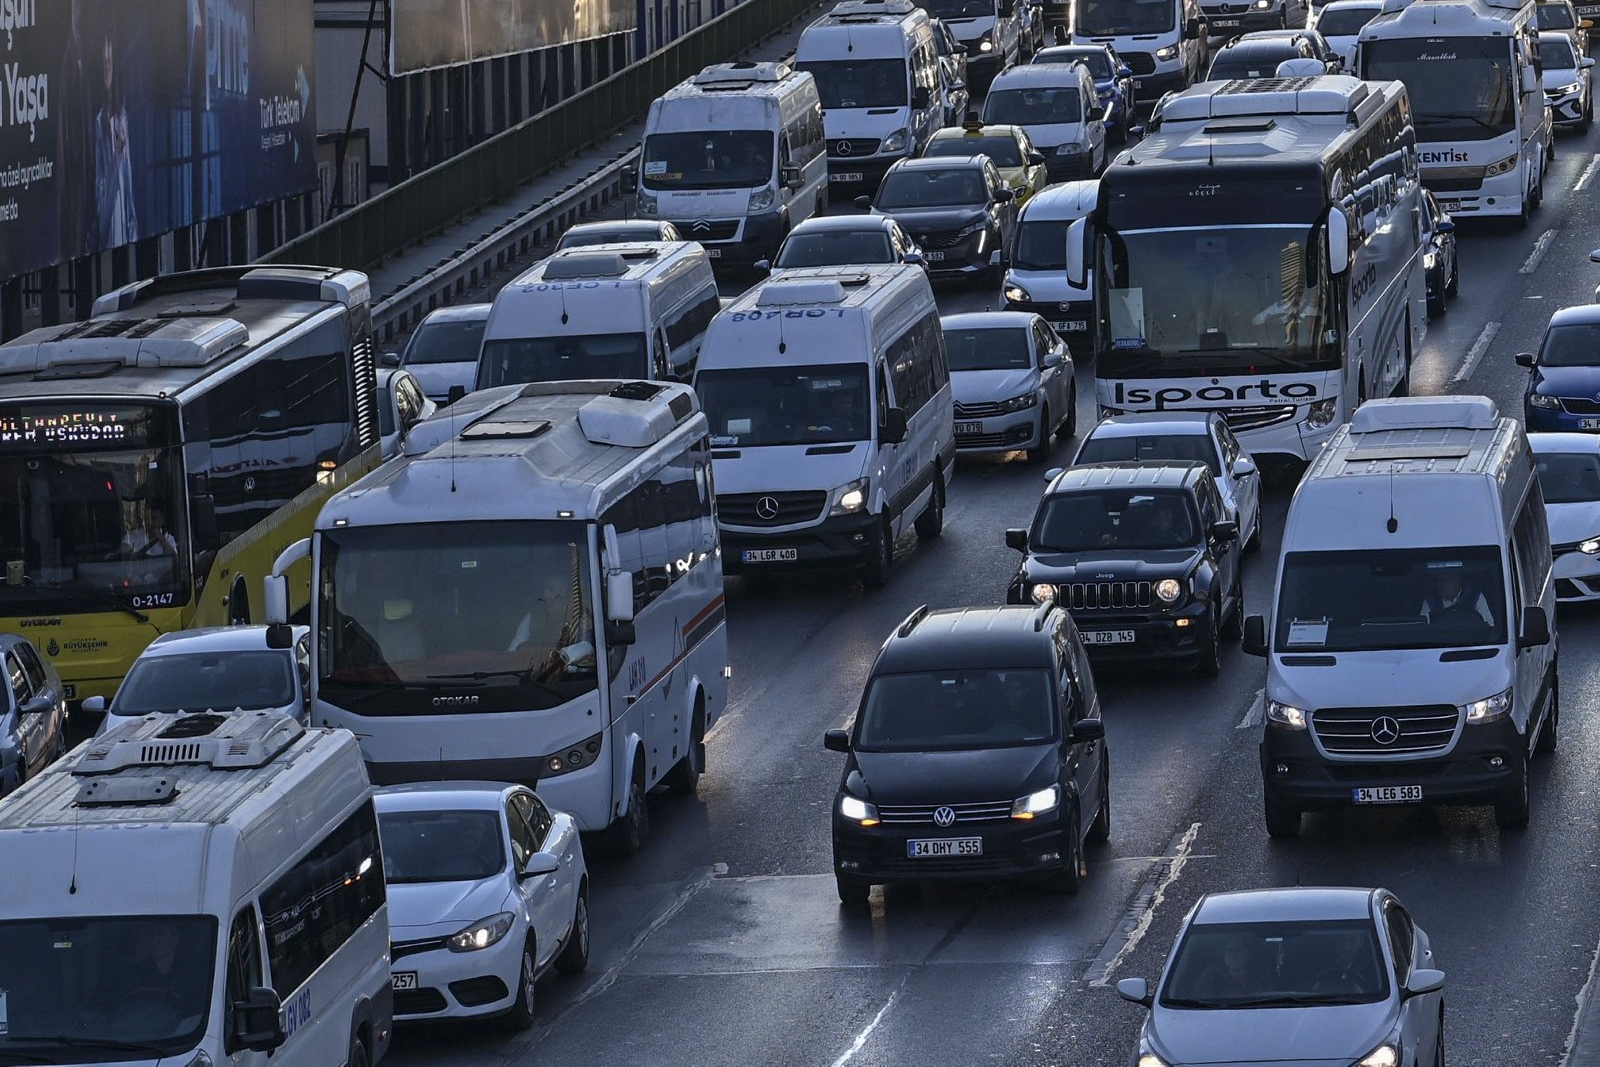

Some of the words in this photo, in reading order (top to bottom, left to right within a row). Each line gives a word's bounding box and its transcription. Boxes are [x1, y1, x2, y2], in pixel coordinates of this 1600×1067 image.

[4, 62, 49, 142] Yaşa
[260, 98, 273, 128] Türk
[275, 93, 300, 126] Telekom
[7, 164, 21, 188] özel
[1114, 379, 1317, 411] Isparta
[966, 422, 981, 432] 079
[1582, 419, 1591, 428] 34
[747, 550, 757, 560] 34
[760, 550, 776, 560] LGR
[132, 592, 174, 607] O-2147
[1080, 631, 1090, 643] 34
[1119, 630, 1135, 642] 145
[432, 694, 480, 707] OTOKAR
[1360, 790, 1373, 800] 34
[1376, 788, 1397, 799] LEG
[1401, 787, 1421, 799] 583
[916, 842, 929, 854] 34
[932, 842, 952, 854] DHY
[959, 841, 980, 853] 555
[393, 974, 415, 989] 257
[299, 988, 311, 1027] 082
